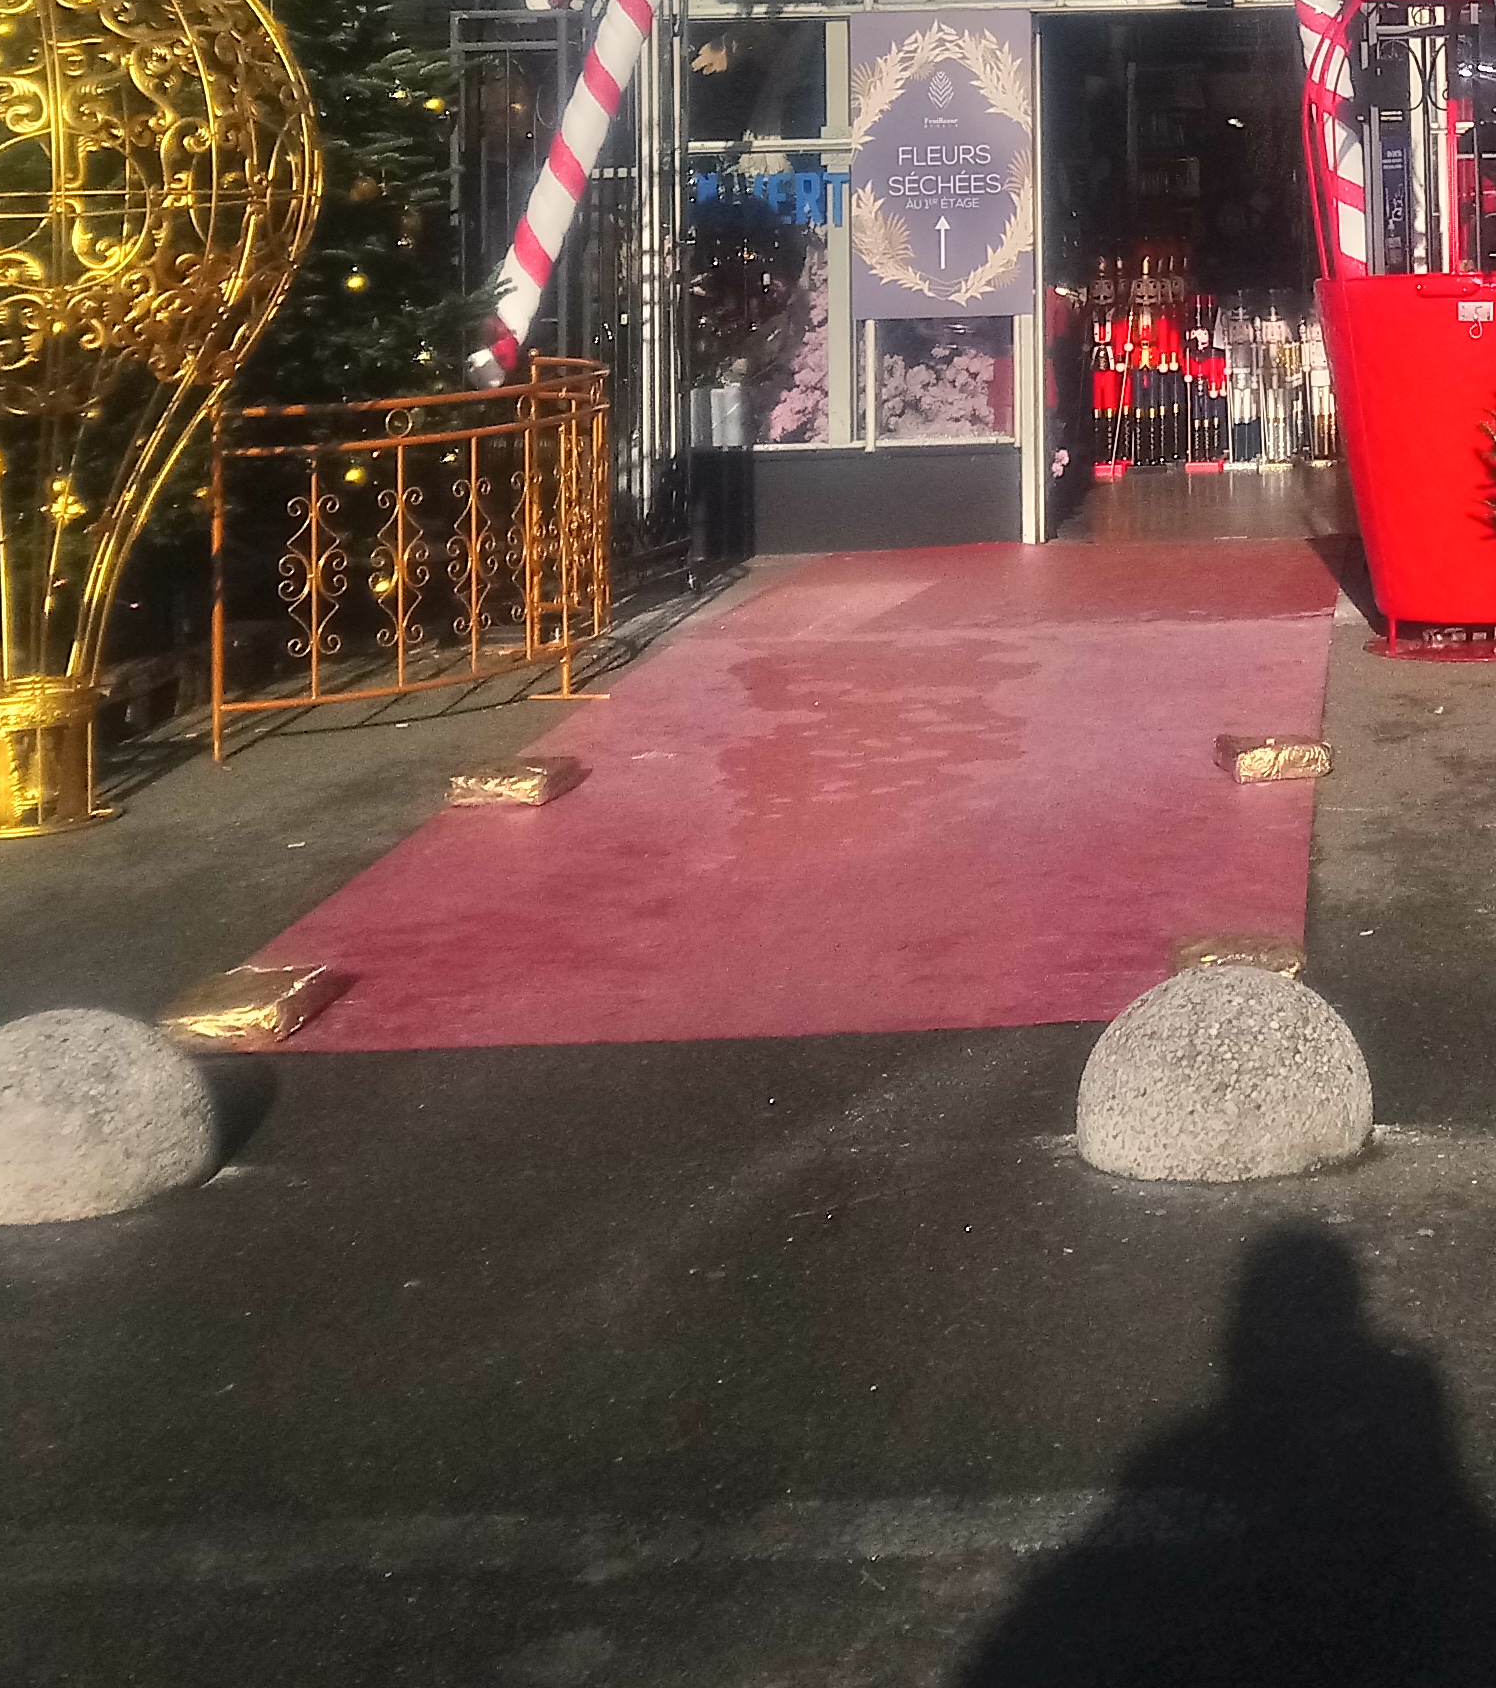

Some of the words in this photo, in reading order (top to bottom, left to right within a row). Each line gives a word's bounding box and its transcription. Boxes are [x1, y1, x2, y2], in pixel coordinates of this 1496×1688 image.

[898, 144, 992, 166] FLEURS
[888, 169, 1002, 196] SÉCHÉES
[940, 196, 980, 209] ÉTAGE
